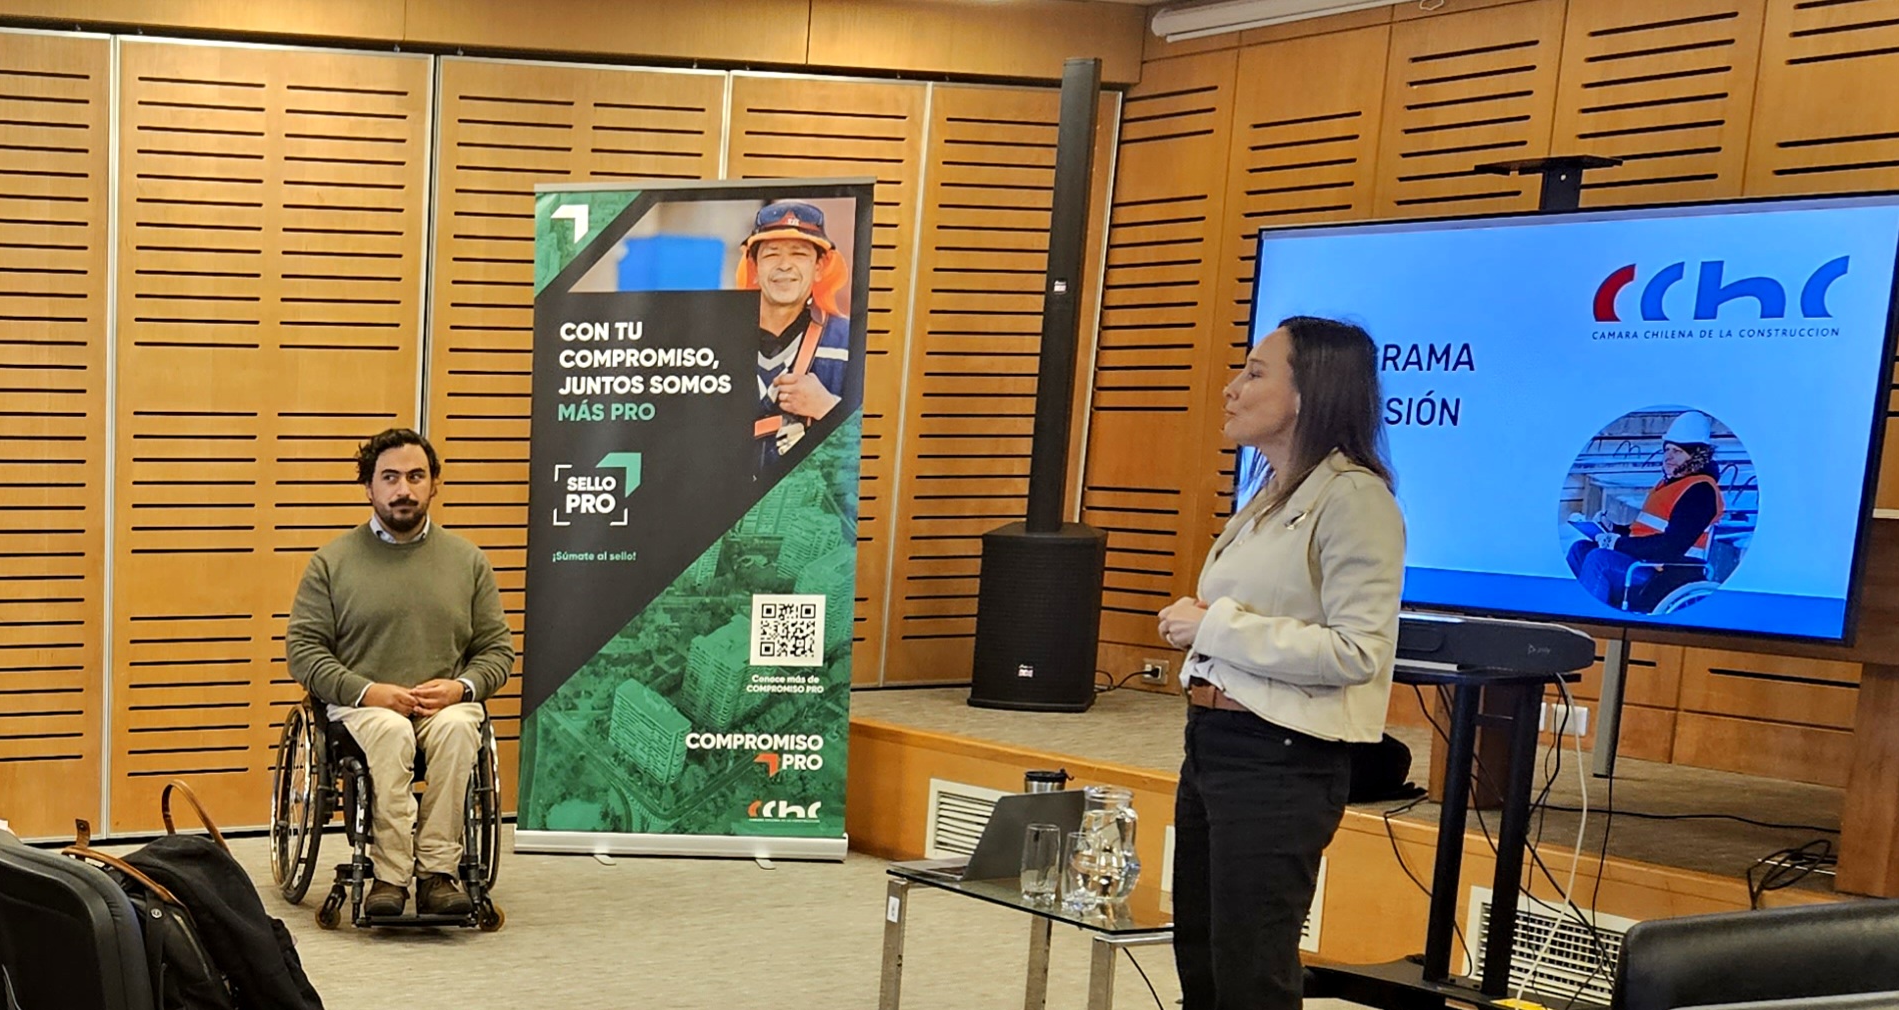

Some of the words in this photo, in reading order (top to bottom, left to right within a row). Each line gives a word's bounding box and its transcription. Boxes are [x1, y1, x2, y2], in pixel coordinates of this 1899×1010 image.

[559, 322, 610, 341] CON
[614, 321, 643, 341] TU
[1591, 330, 1639, 341] CAMARA
[1643, 329, 1694, 340] CHILENA
[1699, 329, 1715, 339] DE
[1719, 329, 1733, 339] LA
[1738, 327, 1840, 339] CONSTRUCCION
[559, 347, 720, 370] COMPROMISO,
[1381, 343, 1475, 371] RAMA
[558, 375, 645, 395] JUNTOS
[649, 375, 732, 394] SOMOS
[558, 399, 605, 421] MÁS
[611, 403, 656, 421] PRO
[1384, 390, 1460, 427] SIÓN
[567, 476, 617, 491] SELLO
[565, 493, 616, 514] PRO
[552, 550, 595, 562] ¡Súmate
[597, 551, 607, 560] al
[609, 551, 637, 561] sello!
[752, 674, 785, 683] Conoce
[787, 674, 806, 684] más
[807, 674, 820, 684] de
[685, 733, 823, 750] COMPROMISO
[782, 754, 823, 770] PRO
